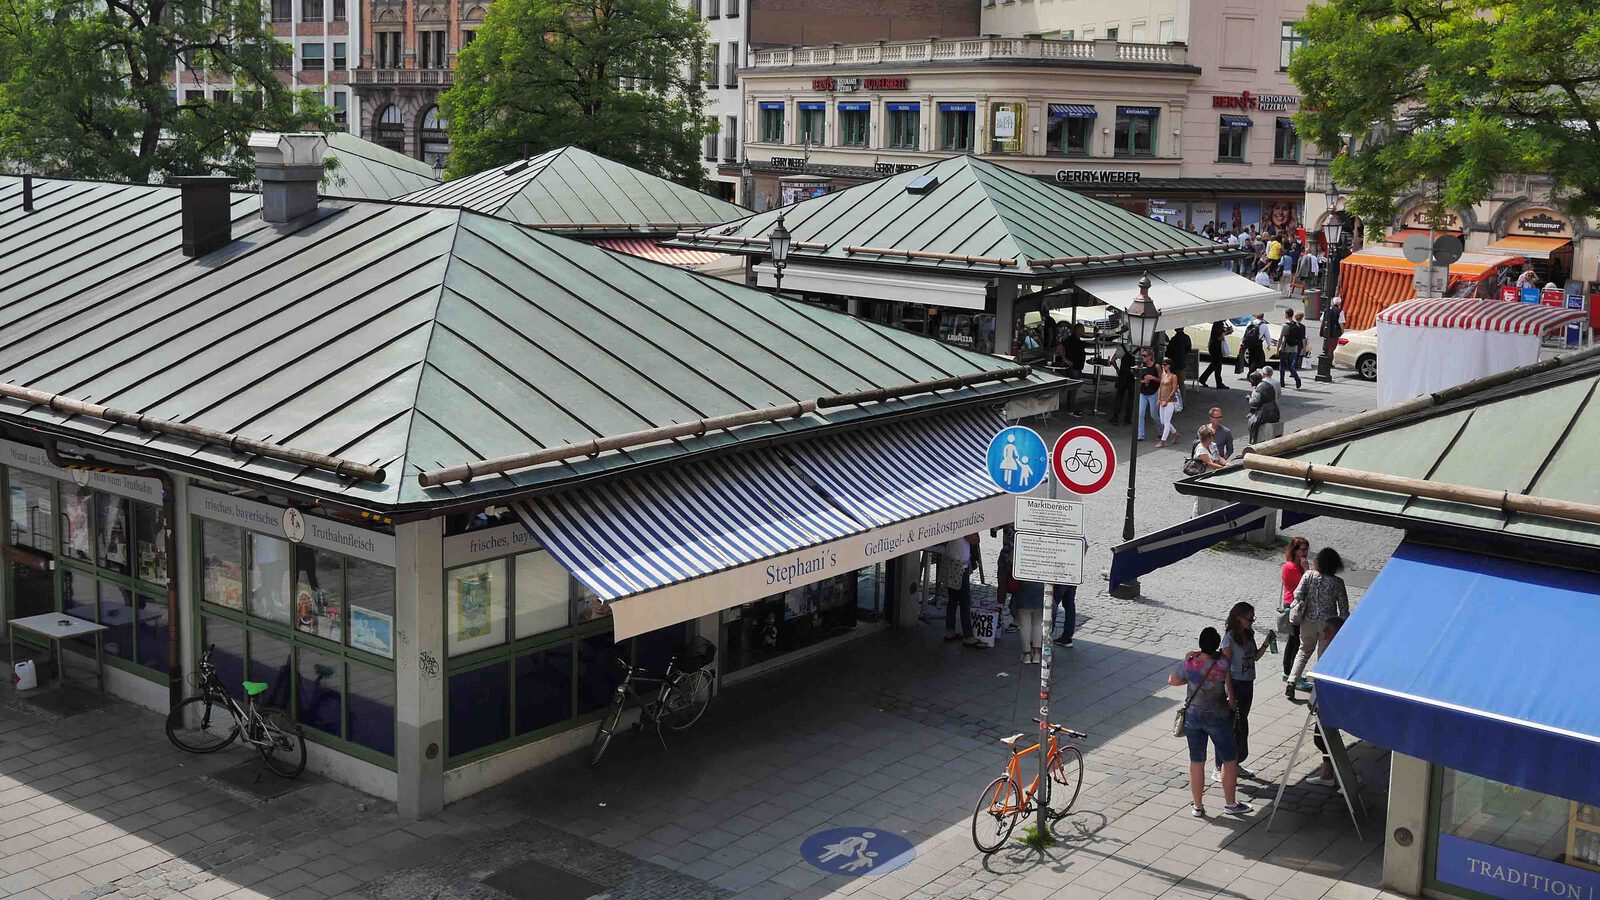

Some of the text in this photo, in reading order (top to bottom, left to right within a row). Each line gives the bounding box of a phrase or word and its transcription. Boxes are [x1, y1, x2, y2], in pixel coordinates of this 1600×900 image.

[1260, 95, 1298, 104] RISTORANTE
[1260, 103, 1288, 111] PIZZERIA
[770, 156, 787, 167] GERRY
[874, 162, 896, 174] GERRY
[1056, 170, 1141, 183] GERRY WEBER
[108, 476, 122, 487] vom
[124, 477, 153, 495] Truthahn
[1027, 500, 1073, 511] Marktbereich
[204, 499, 375, 553] frisches, bayerisches Truthahnfleisch
[864, 511, 985, 557] Geflügel- & Feinkostparadies
[470, 535, 510, 553] frisches,
[1467, 857, 1581, 900] TRADITION
